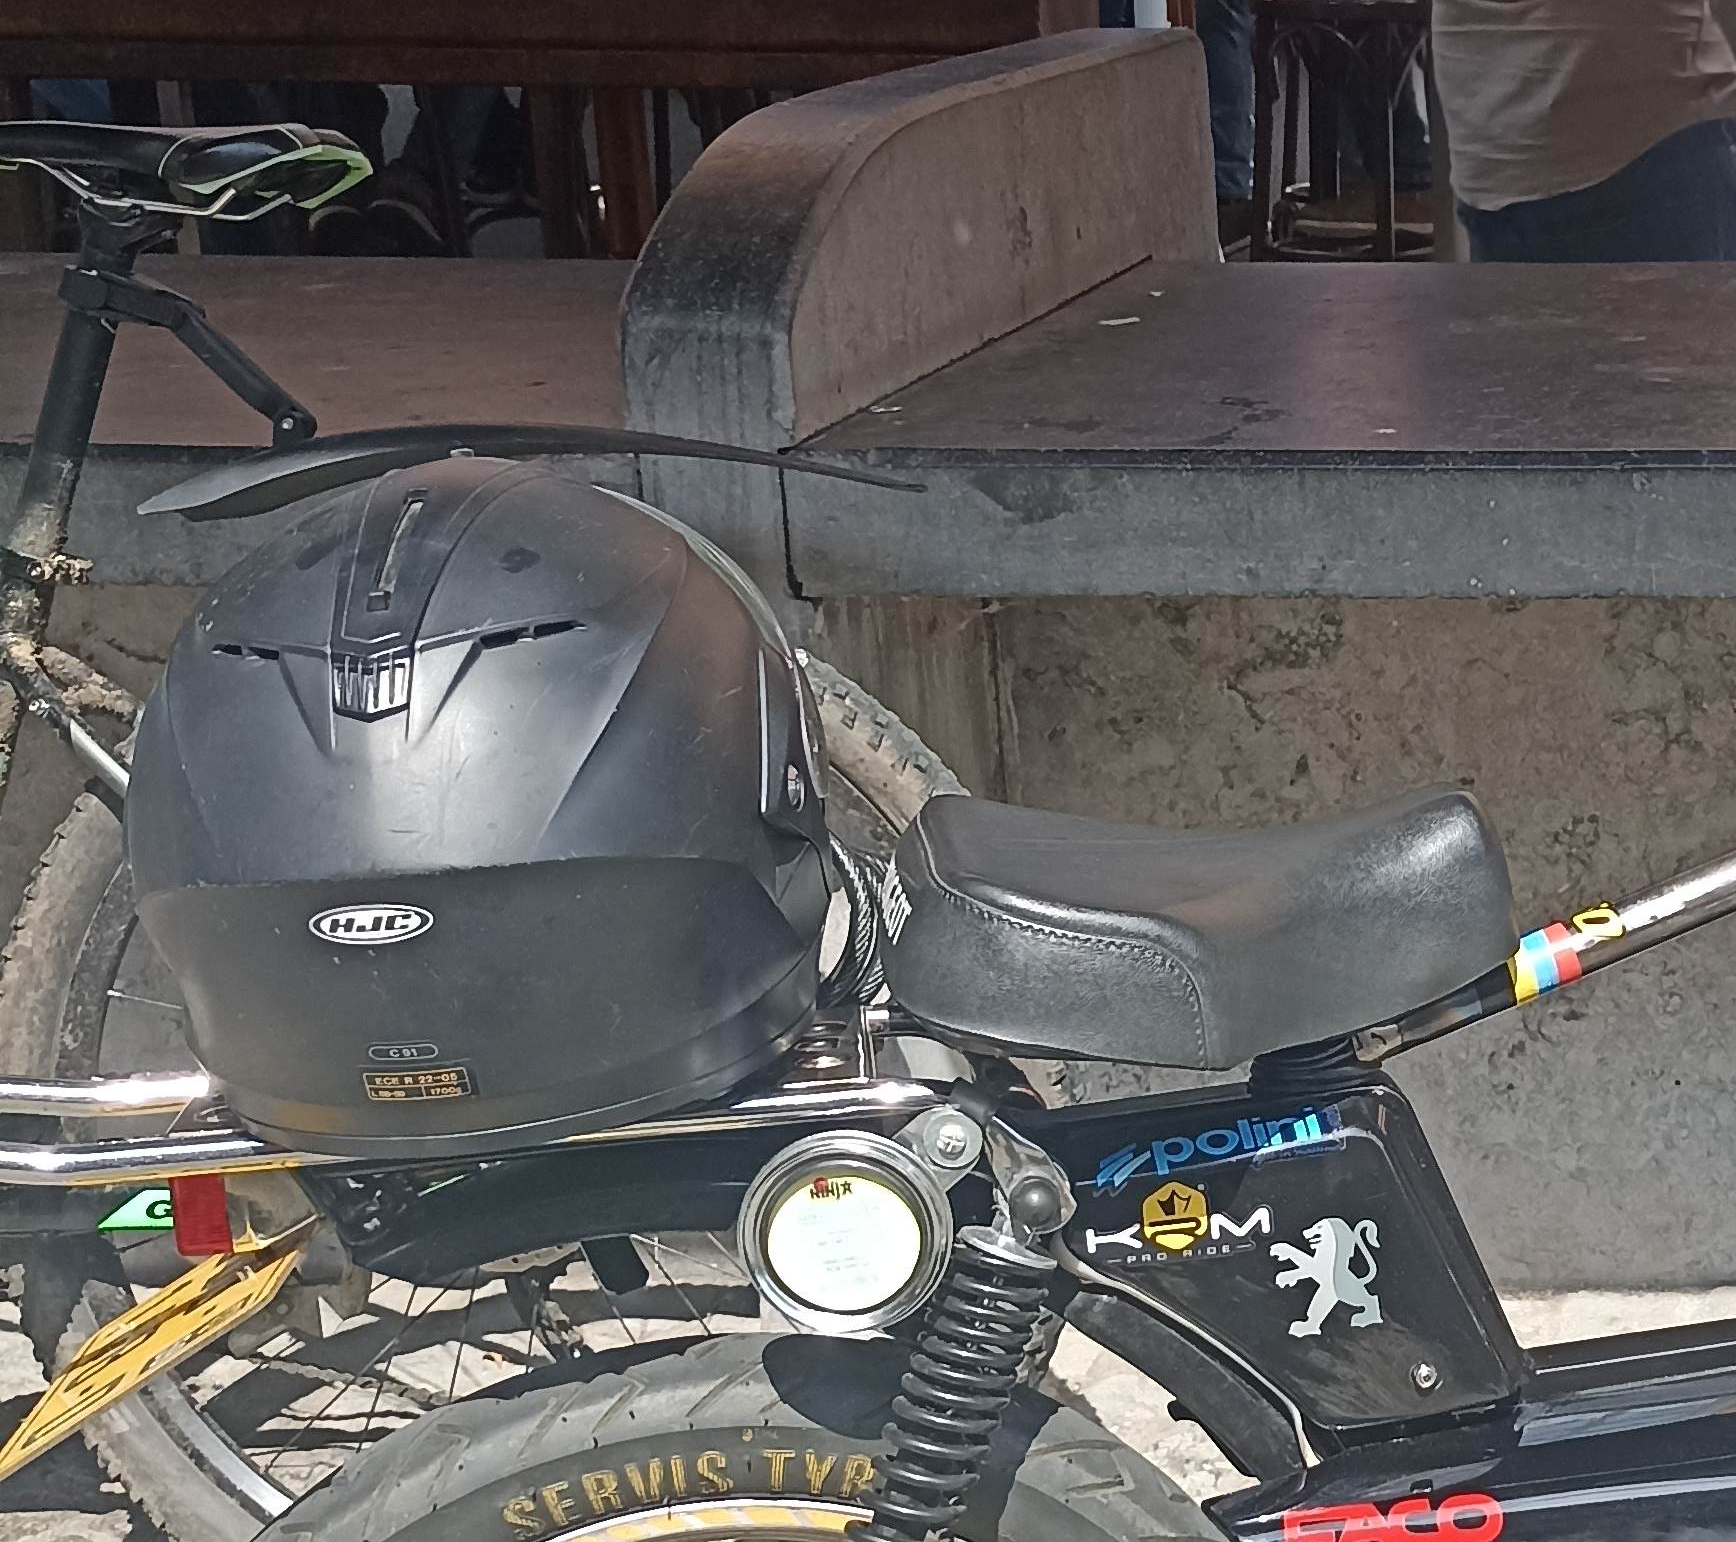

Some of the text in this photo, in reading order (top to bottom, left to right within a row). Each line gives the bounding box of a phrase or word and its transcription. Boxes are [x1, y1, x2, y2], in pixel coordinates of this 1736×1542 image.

[328, 914, 412, 934] HJC
[1151, 1107, 1323, 1176] polini
[502, 1447, 876, 1539] SERVIS TYR
